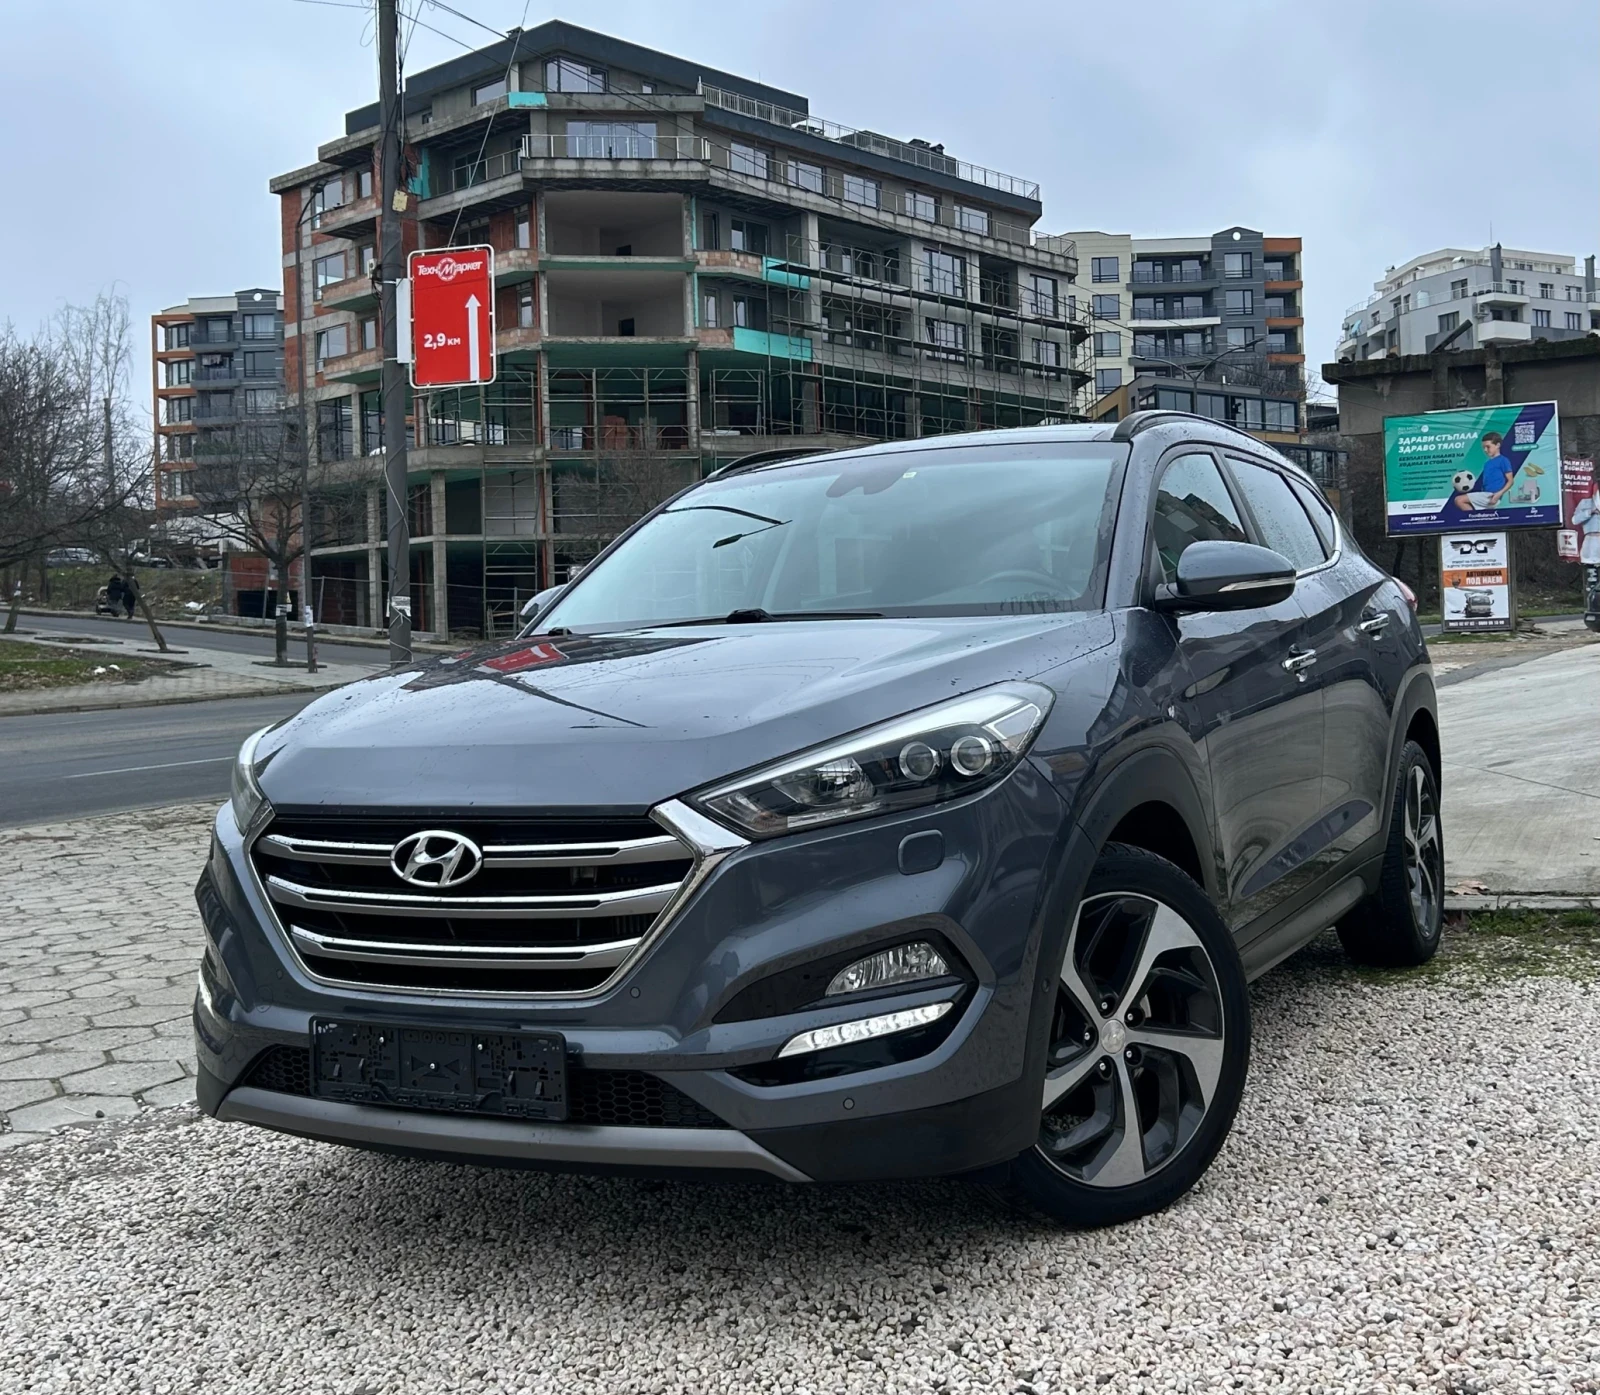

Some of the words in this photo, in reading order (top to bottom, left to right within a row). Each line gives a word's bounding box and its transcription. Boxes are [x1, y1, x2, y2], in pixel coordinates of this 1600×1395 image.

[423, 333, 446, 350] 2,9
[1398, 435, 1434, 445] ЗДРАВИ
[1435, 432, 1478, 441] СТЪПАЛА
[1398, 444, 1436, 454] ЗДРАВО
[1437, 442, 1465, 450] ТЯЛО!
[1466, 576, 1481, 585] ПОД
[1482, 576, 1502, 584] НАЕМ
